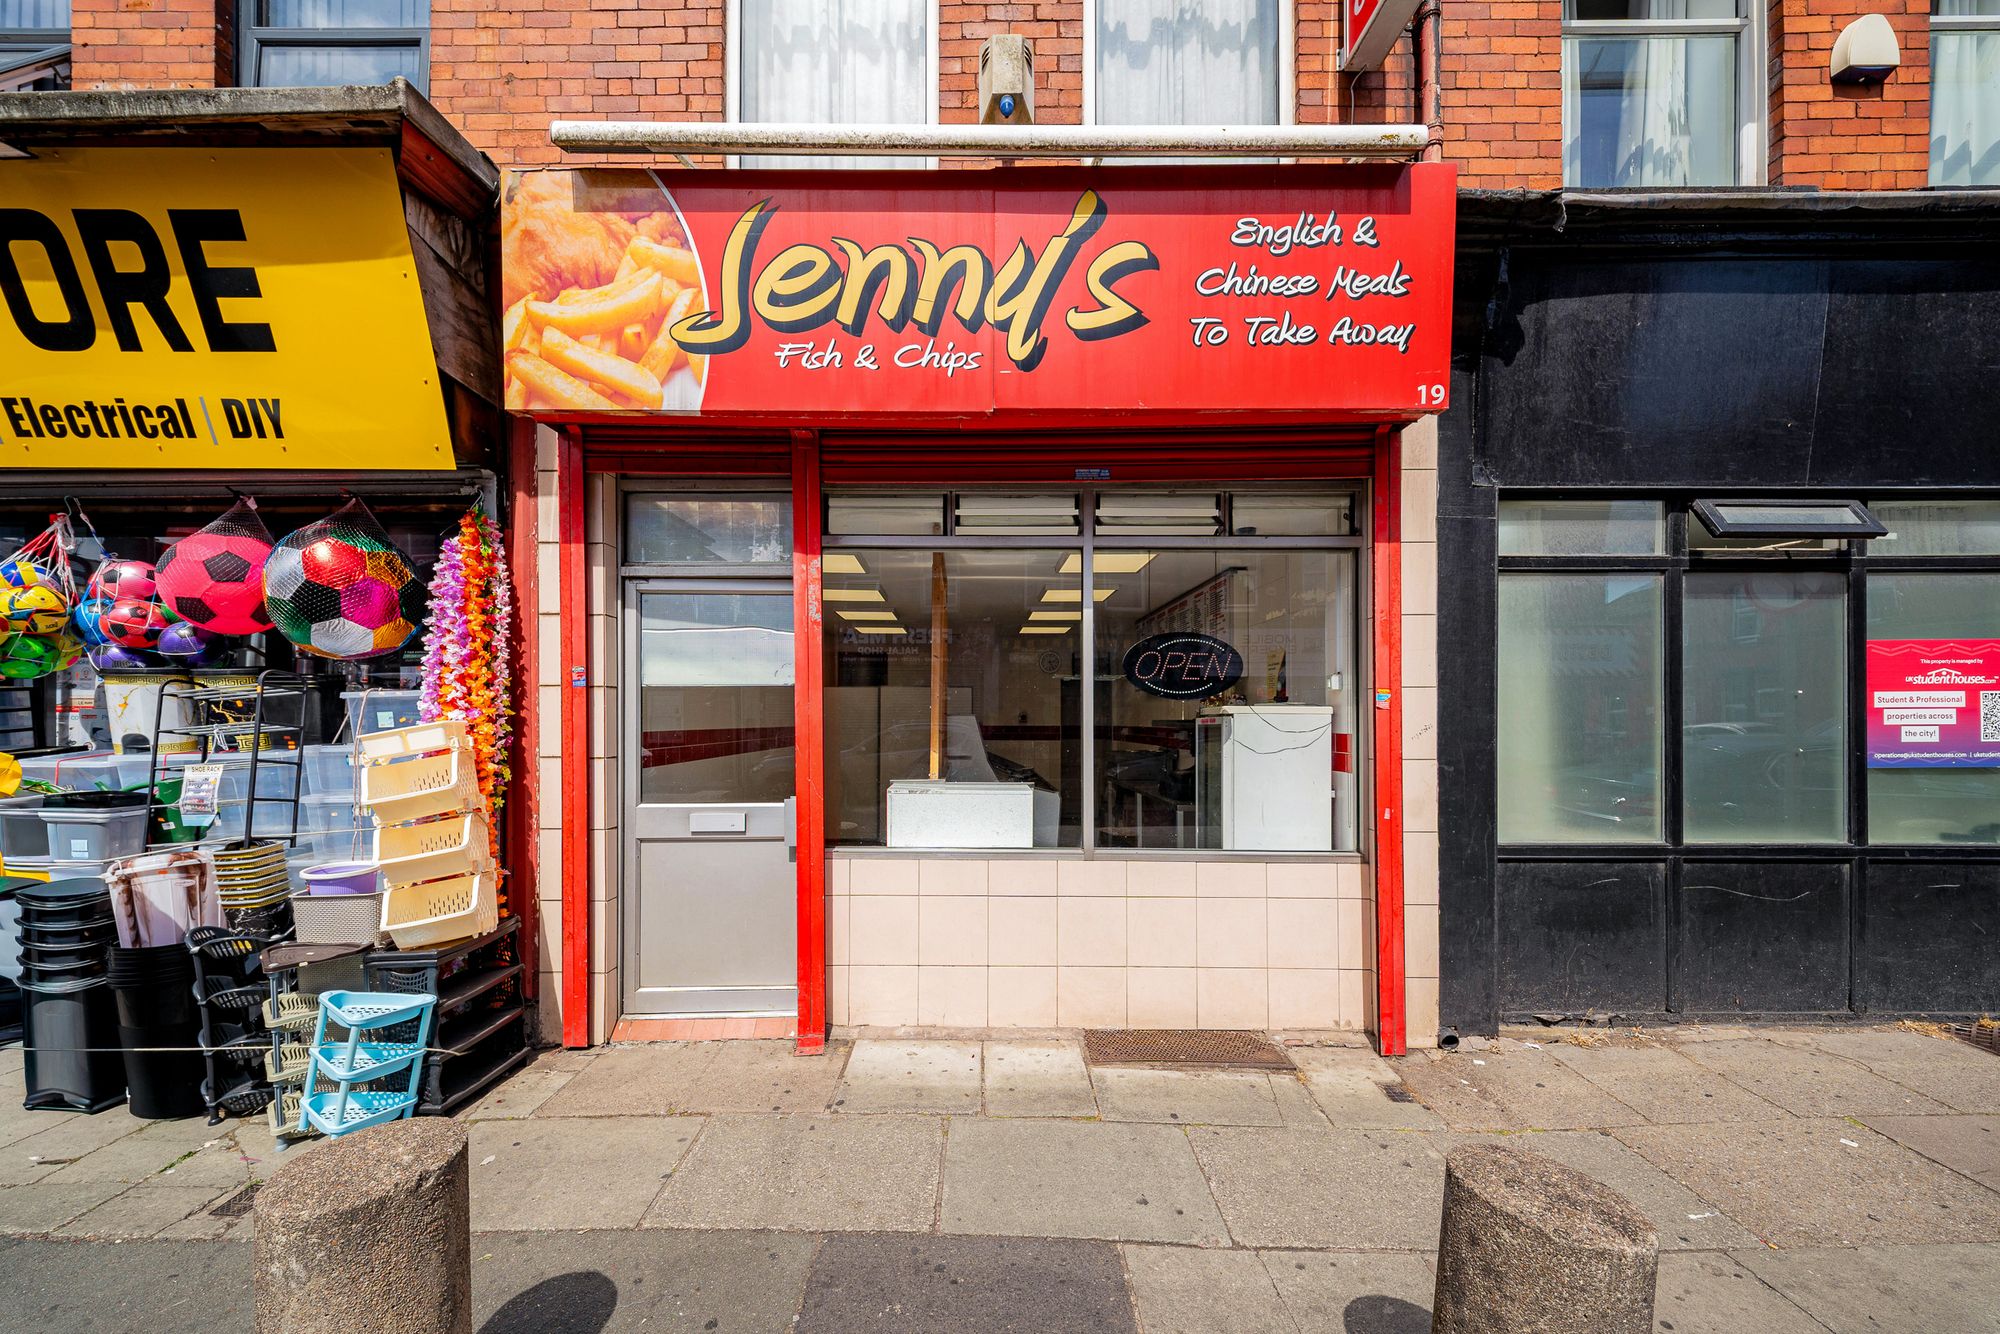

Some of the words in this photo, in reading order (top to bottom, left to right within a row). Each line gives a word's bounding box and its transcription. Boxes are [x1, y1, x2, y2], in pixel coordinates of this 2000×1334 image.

[1230, 209, 1343, 256] English
[1352, 215, 1380, 248] &
[0, 208, 277, 352] ORE
[669, 187, 1160, 372] Jenny's
[1195, 261, 1319, 297] Chinese
[1326, 259, 1413, 301] Meals
[1189, 315, 1229, 346] To
[1244, 310, 1318, 346] Take
[1328, 316, 1416, 354] Away
[775, 339, 843, 371] Fish
[853, 344, 880, 371] &
[894, 339, 982, 377] Chips
[1416, 384, 1445, 405] 19
[0, 397, 197, 439] Electrical
[221, 398, 285, 439] DIY
[1135, 651, 1232, 681] OPEN
[1877, 696, 1908, 704] Student
[1916, 696, 1962, 704] Professional
[1887, 713, 1927, 721] properties
[1919, 730, 1936, 738] city!
